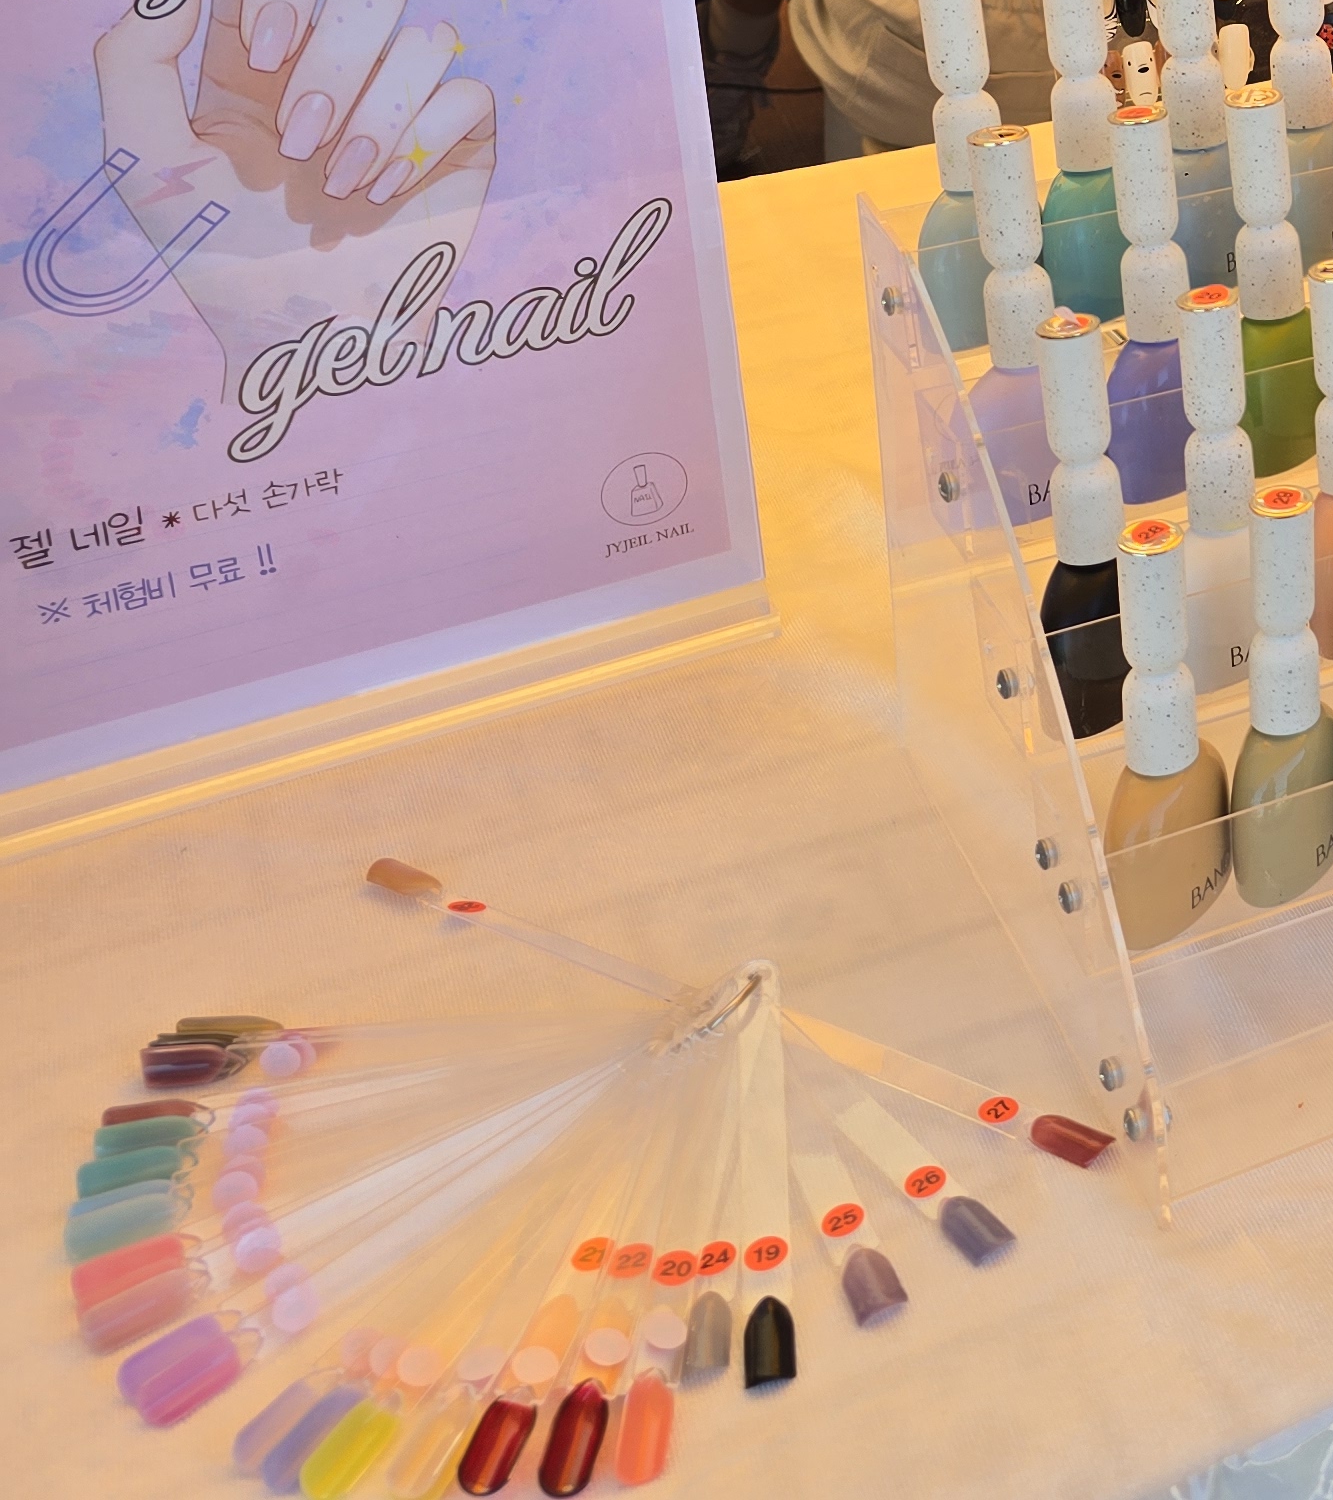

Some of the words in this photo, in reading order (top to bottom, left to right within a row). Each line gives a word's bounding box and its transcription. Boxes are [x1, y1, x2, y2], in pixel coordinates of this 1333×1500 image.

[192, 488, 252, 522] 다섯
[261, 468, 344, 509] 손가락
[9, 527, 55, 570] 젤
[69, 505, 146, 548] 네일
[605, 533, 653, 558] JYJEIL
[656, 522, 695, 542] NAIL
[82, 571, 177, 619] 체험비
[189, 556, 246, 592] 무료
[256, 542, 278, 576] !!
[985, 1099, 1012, 1120] 27
[910, 1170, 942, 1195] 26
[828, 1211, 860, 1232] 25
[616, 1251, 648, 1271] 22
[700, 1247, 732, 1270] 24
[752, 1243, 782, 1265] 19
[658, 1259, 694, 1279] 20
